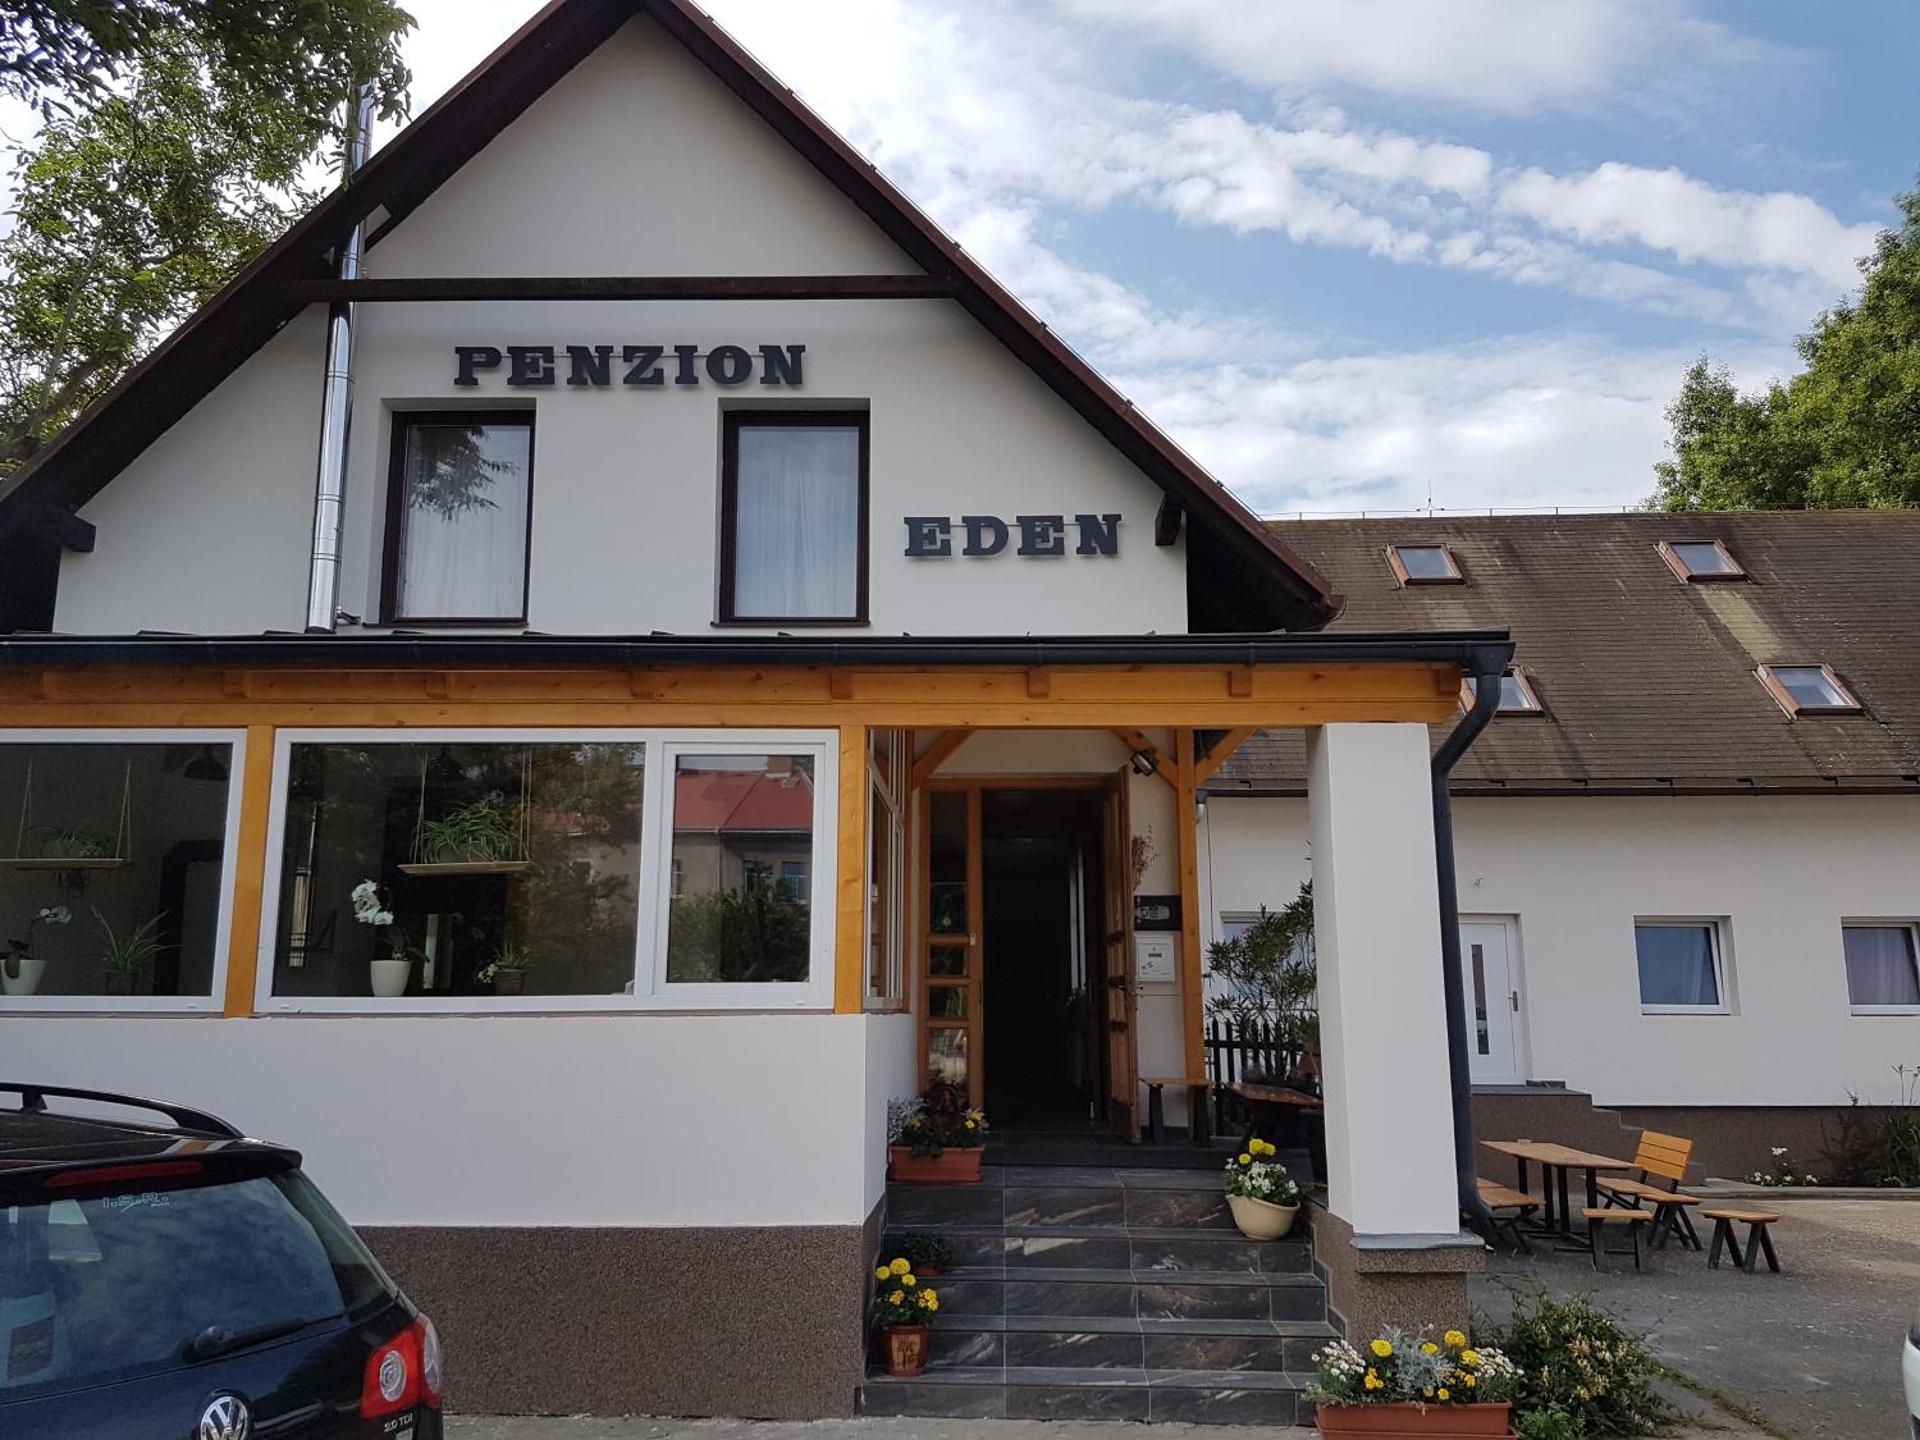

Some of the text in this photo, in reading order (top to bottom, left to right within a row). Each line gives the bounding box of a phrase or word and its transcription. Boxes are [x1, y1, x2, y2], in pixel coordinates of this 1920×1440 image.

[453, 344, 806, 386] PENZION
[903, 513, 1122, 557] EDEN
[399, 1412, 413, 1426] TDI
